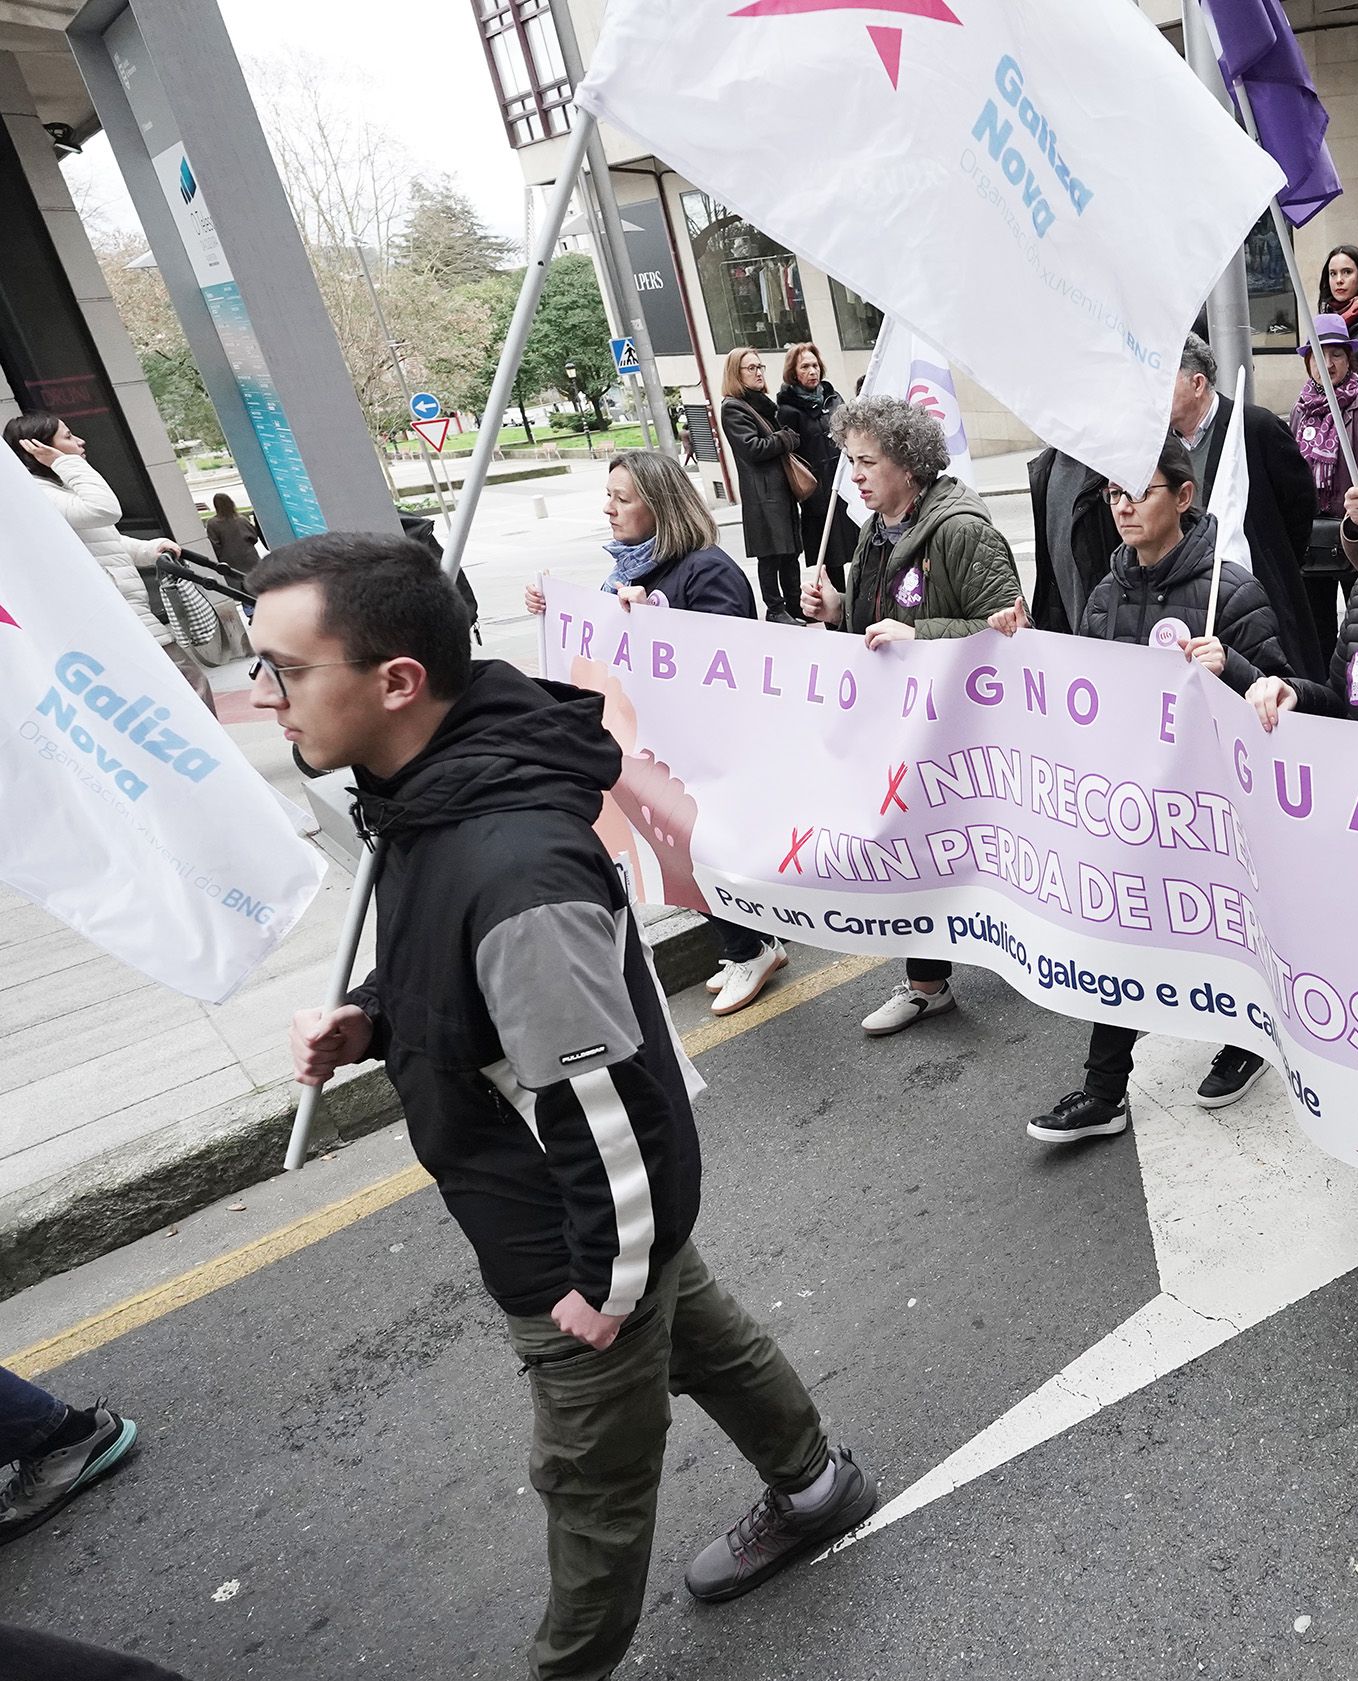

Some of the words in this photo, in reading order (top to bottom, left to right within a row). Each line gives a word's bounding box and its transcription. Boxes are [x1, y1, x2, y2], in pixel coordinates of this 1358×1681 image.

[971, 98, 1056, 239] Nova
[995, 54, 1095, 217] Galiza
[633, 271, 664, 291] LPERS
[1126, 331, 1162, 370] BNG
[35, 686, 149, 802] Nova
[55, 651, 221, 783] Galiza
[559, 612, 858, 711] TRABALLO
[902, 664, 1101, 727] DIGNO
[1159, 691, 1178, 744] E
[815, 828, 918, 882] NIN
[926, 823, 1073, 914] PERDA
[1078, 861, 1153, 931] DE
[916, 746, 1023, 808] NIN
[1030, 756, 1260, 893] RECORTES
[194, 875, 222, 898] do
[222, 888, 276, 926] BNG
[715, 885, 765, 919] Por
[772, 907, 815, 929] un
[824, 909, 934, 936] Correo
[947, 911, 1033, 975] público,
[1038, 953, 1145, 1007] galego
[1157, 982, 1180, 1007] e
[1190, 982, 1238, 1018] de
[1246, 1002, 1322, 1118] calade
